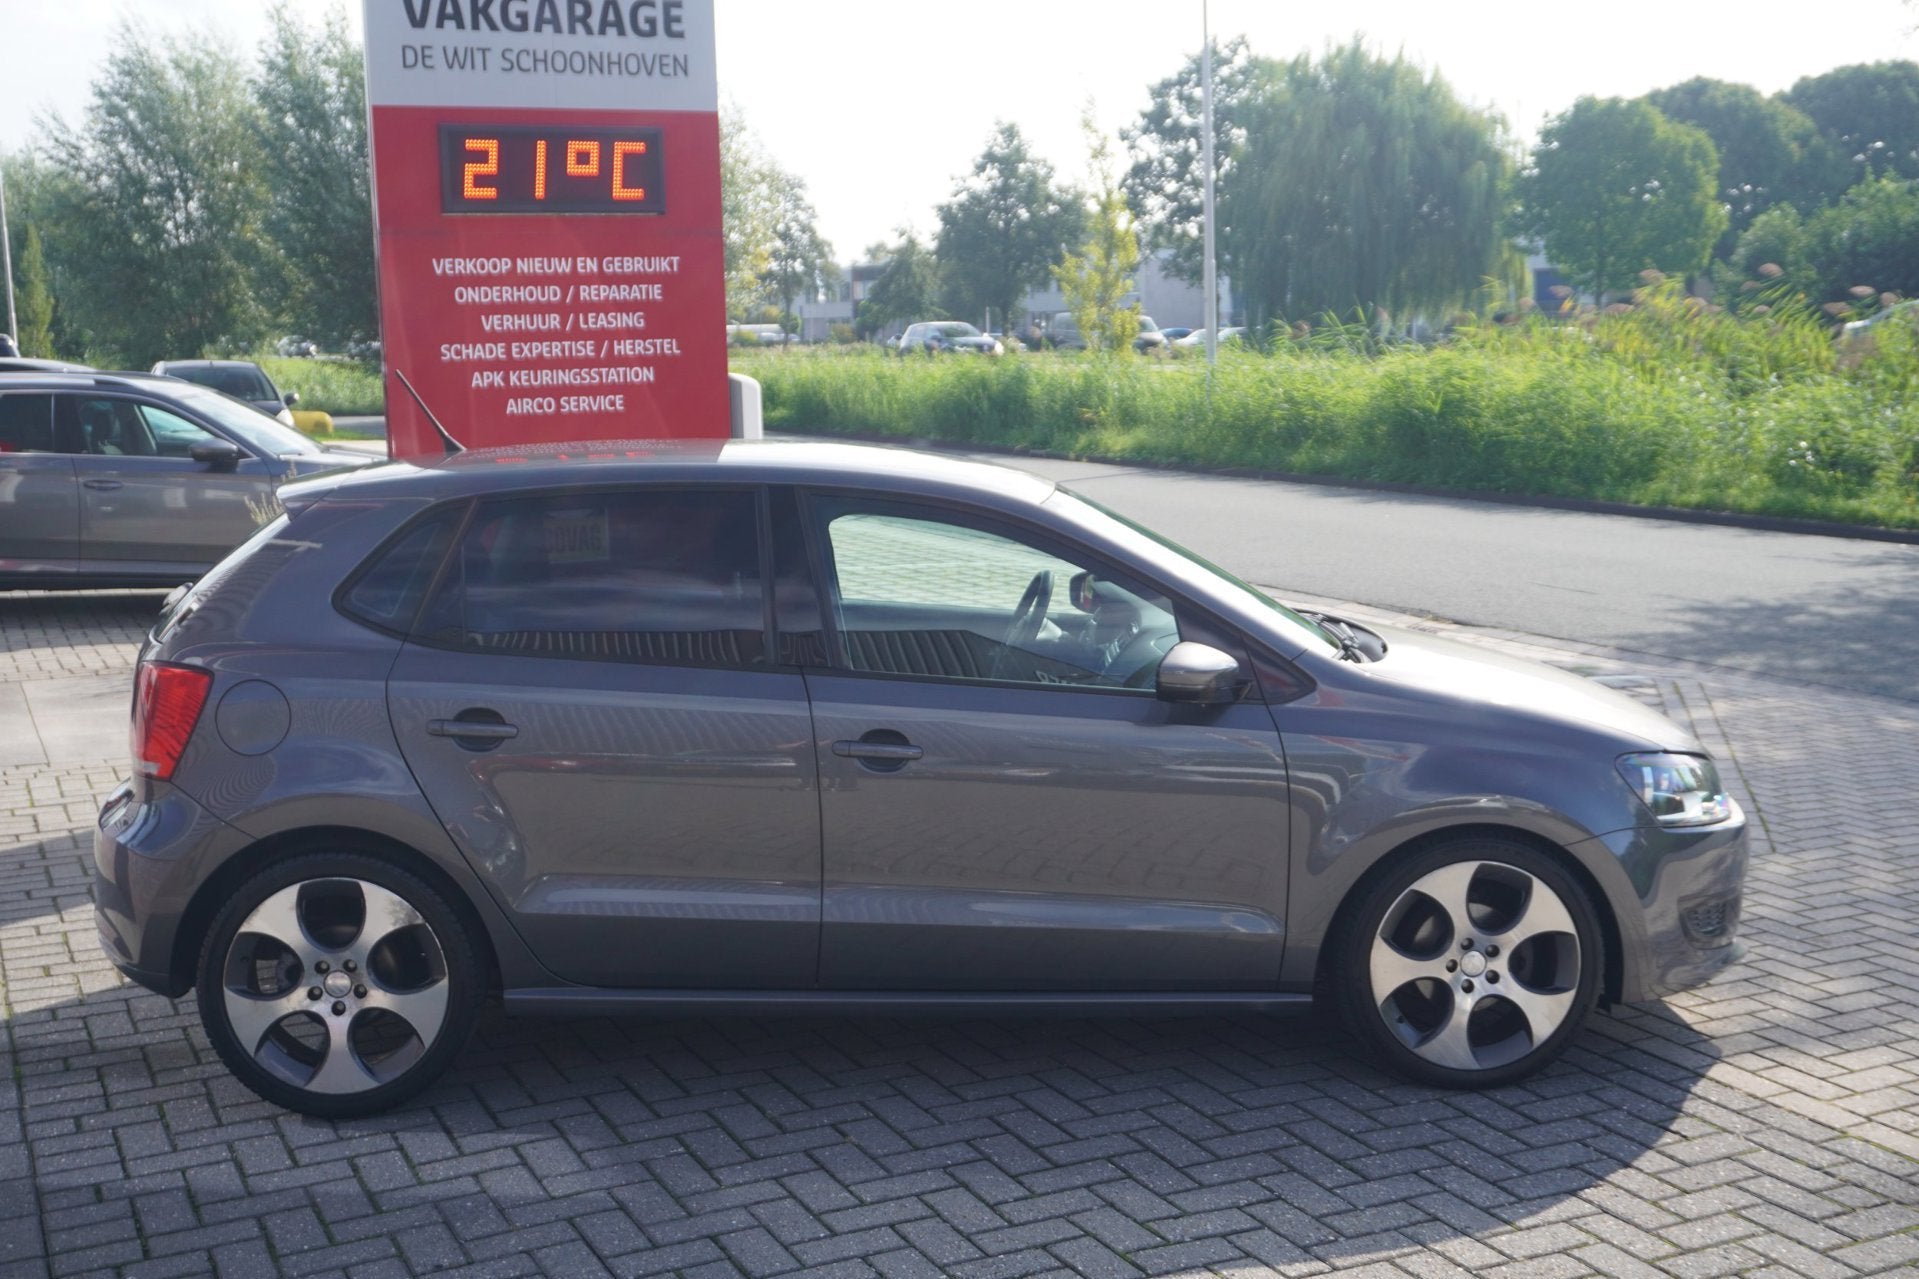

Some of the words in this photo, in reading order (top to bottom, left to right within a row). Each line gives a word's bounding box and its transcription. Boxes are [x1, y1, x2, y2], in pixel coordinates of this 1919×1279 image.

[403, 0, 686, 39] VAKGARAGE
[401, 44, 434, 70] DE
[442, 46, 492, 71] WIT
[500, 47, 689, 77] SCHOONHOVEN
[432, 257, 512, 275] VERKOOP
[516, 257, 572, 274] NIEUW
[576, 256, 598, 273] EN
[602, 256, 680, 273] GEBRUIKT
[454, 285, 561, 303] ONDERHOUD
[566, 285, 575, 303] /
[579, 284, 663, 301] REPARATIE
[481, 313, 561, 331] VERHUUR
[565, 313, 574, 331] /
[579, 312, 645, 329] LEASING
[440, 343, 507, 360] SCHADE
[511, 341, 595, 358] EXPERTISE
[600, 340, 609, 358] /
[613, 338, 681, 356] HERSTEL
[471, 371, 505, 388] APK
[509, 366, 655, 386] KEURINGSSTATION
[506, 397, 556, 414] AIRCO
[560, 394, 625, 412] SERVICE
